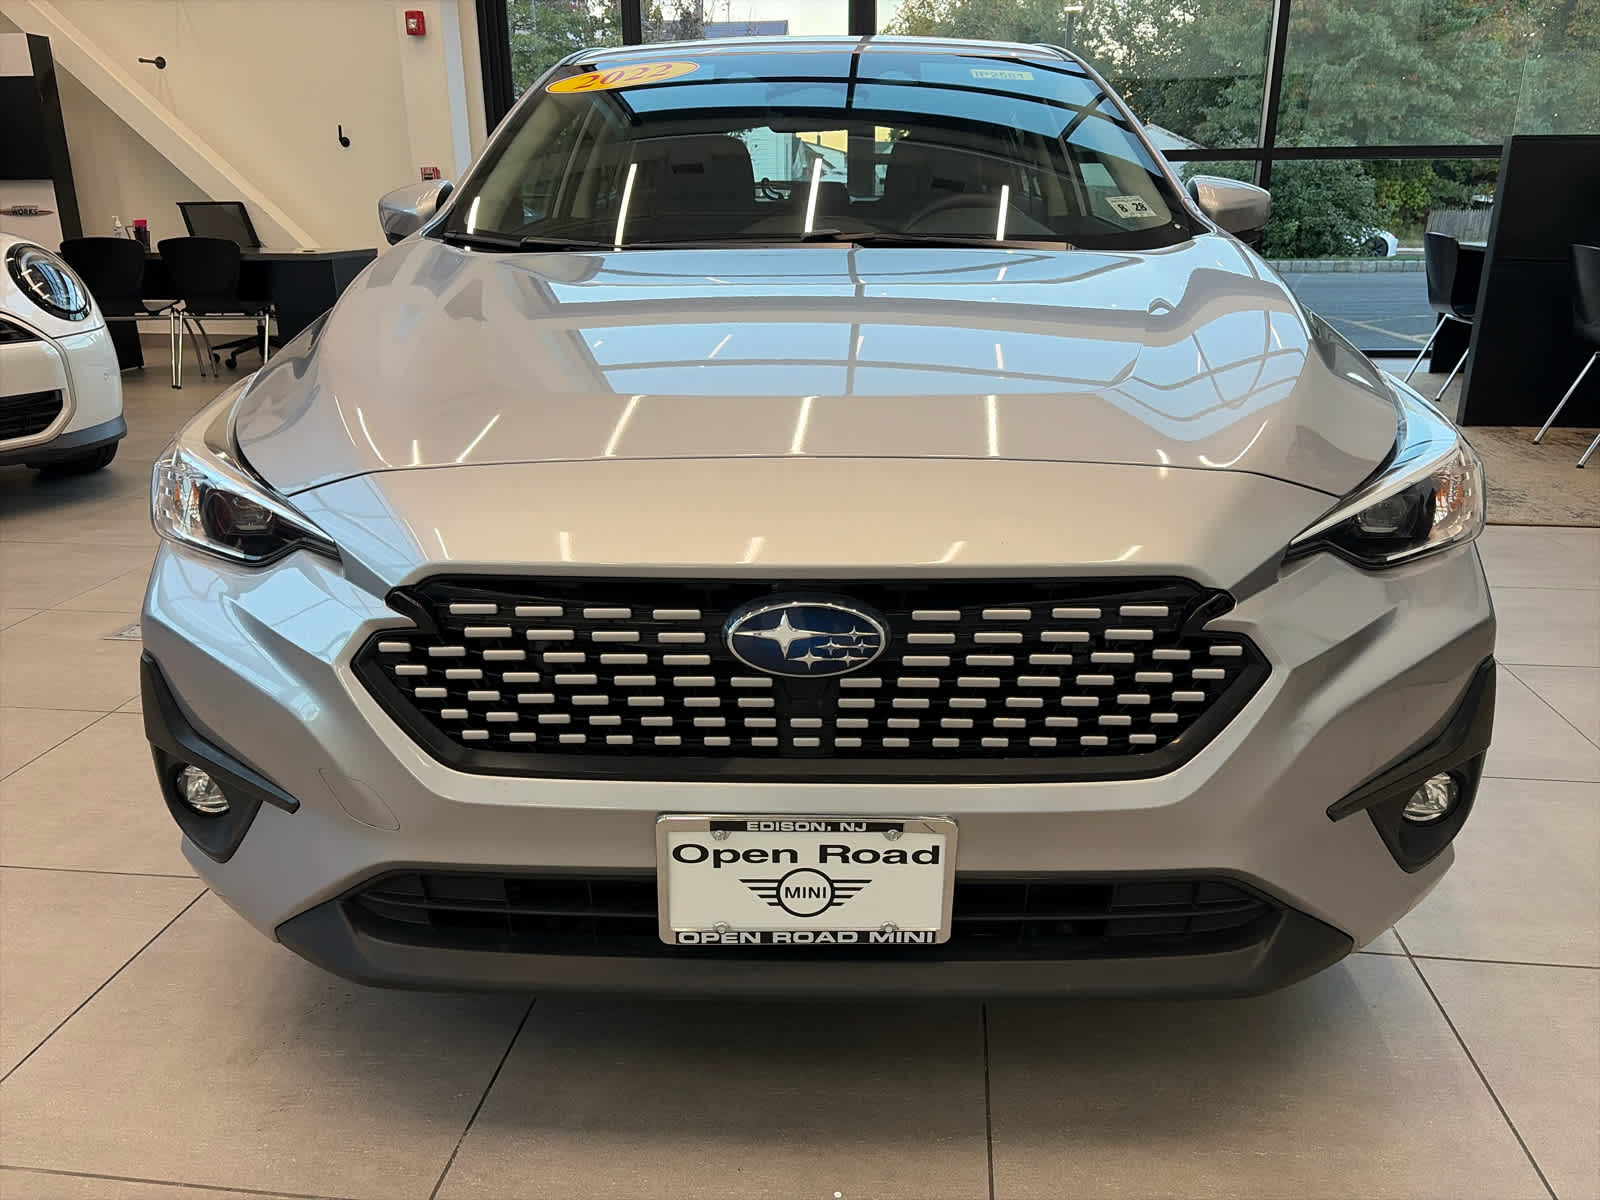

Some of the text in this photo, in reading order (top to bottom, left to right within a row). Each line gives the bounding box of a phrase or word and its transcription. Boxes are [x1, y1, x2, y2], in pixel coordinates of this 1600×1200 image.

[573, 63, 673, 90] 2022
[1118, 204, 1128, 212] 8
[746, 821, 867, 832] EDISON, NJ
[672, 843, 940, 869] Open Road
[784, 886, 827, 899] MINI
[678, 931, 933, 944] OPEN ROAD MINI
